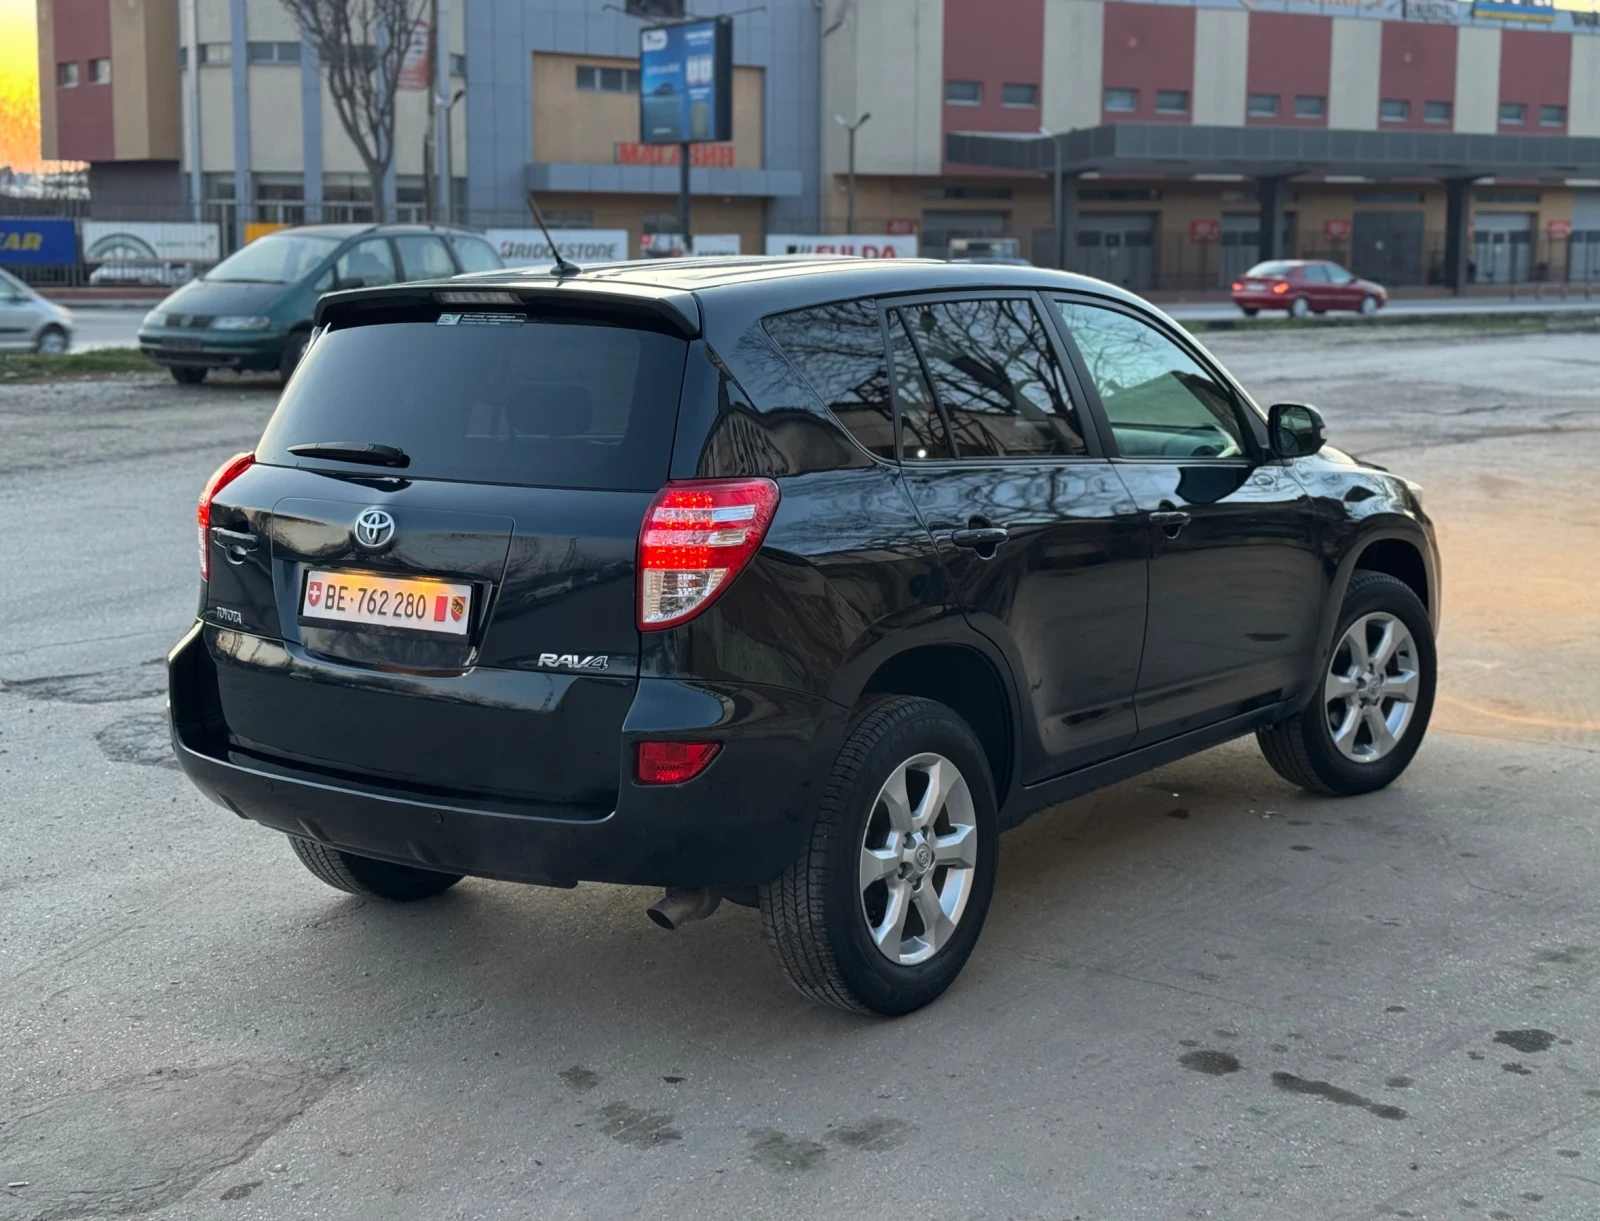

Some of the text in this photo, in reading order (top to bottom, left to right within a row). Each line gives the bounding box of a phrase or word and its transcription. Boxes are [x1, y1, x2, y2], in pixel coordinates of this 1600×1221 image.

[0, 232, 44, 252] AR
[501, 240, 618, 259] BRIDGESTONE
[815, 244, 897, 259] FULDA
[216, 606, 242, 624] TOYOTA
[537, 653, 609, 671] RAV4
